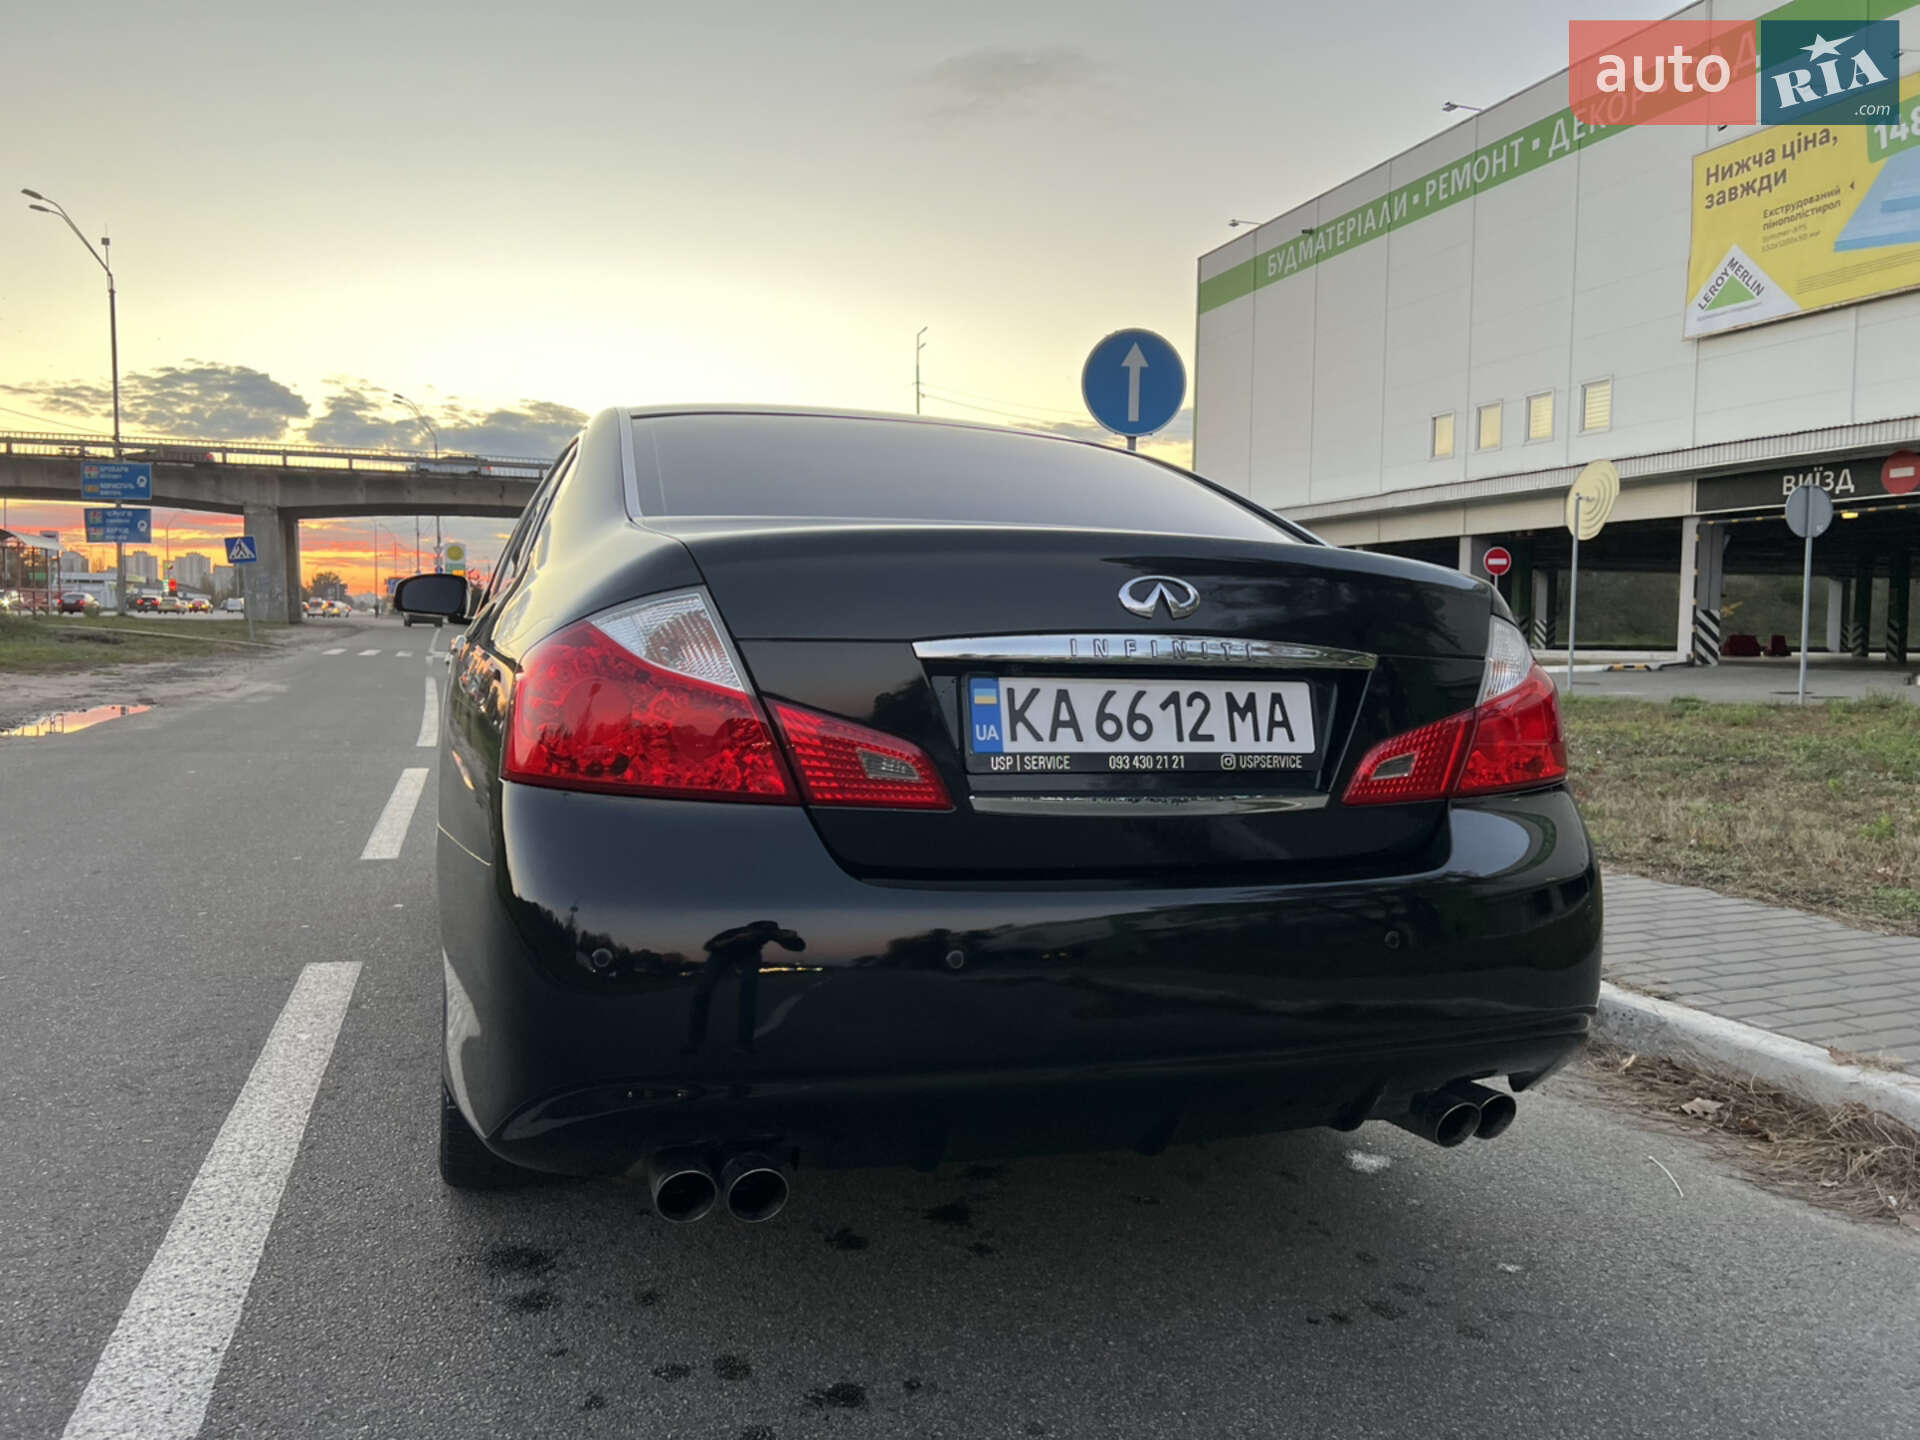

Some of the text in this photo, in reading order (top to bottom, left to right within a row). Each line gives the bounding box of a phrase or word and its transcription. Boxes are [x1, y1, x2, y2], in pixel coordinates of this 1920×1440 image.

[1705, 128, 1839, 187] Нижча ціна,
[1704, 168, 1788, 210] завжди
[1267, 196, 1408, 277] БУДМАТЕРІАЛИ
[1425, 136, 1525, 206] РЕМОНТ
[1697, 268, 1730, 310] LEROY
[1727, 257, 1765, 297] MERLIN
[1782, 466, 1855, 495] ВИЇЗД
[1070, 638, 1253, 662] INFINITI
[1006, 688, 1295, 743] KA 6612 MA
[975, 724, 999, 742] UA
[991, 756, 1071, 771] USP SERVICE
[1109, 755, 1185, 769] 093 430 21 21
[1239, 754, 1303, 769] USPSERVICE
